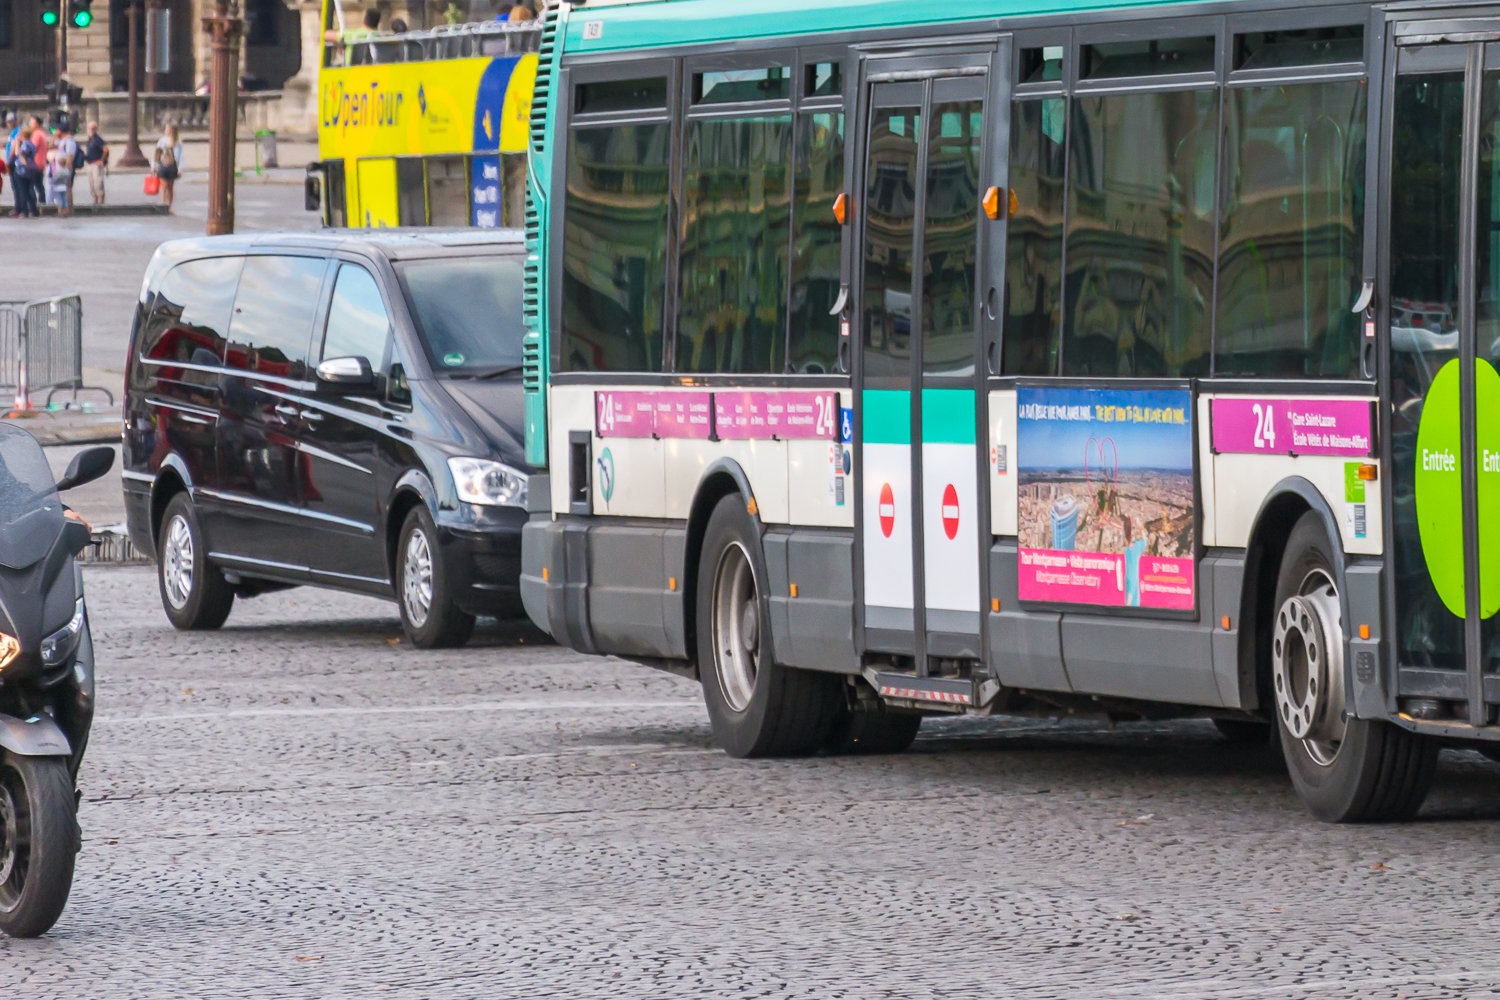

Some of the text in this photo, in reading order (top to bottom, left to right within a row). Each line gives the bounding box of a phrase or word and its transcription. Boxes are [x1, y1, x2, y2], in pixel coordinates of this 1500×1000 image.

[599, 393, 614, 431] 24
[815, 395, 834, 435] 24
[1252, 403, 1276, 449] 24
[1422, 448, 1455, 472] Entrée
